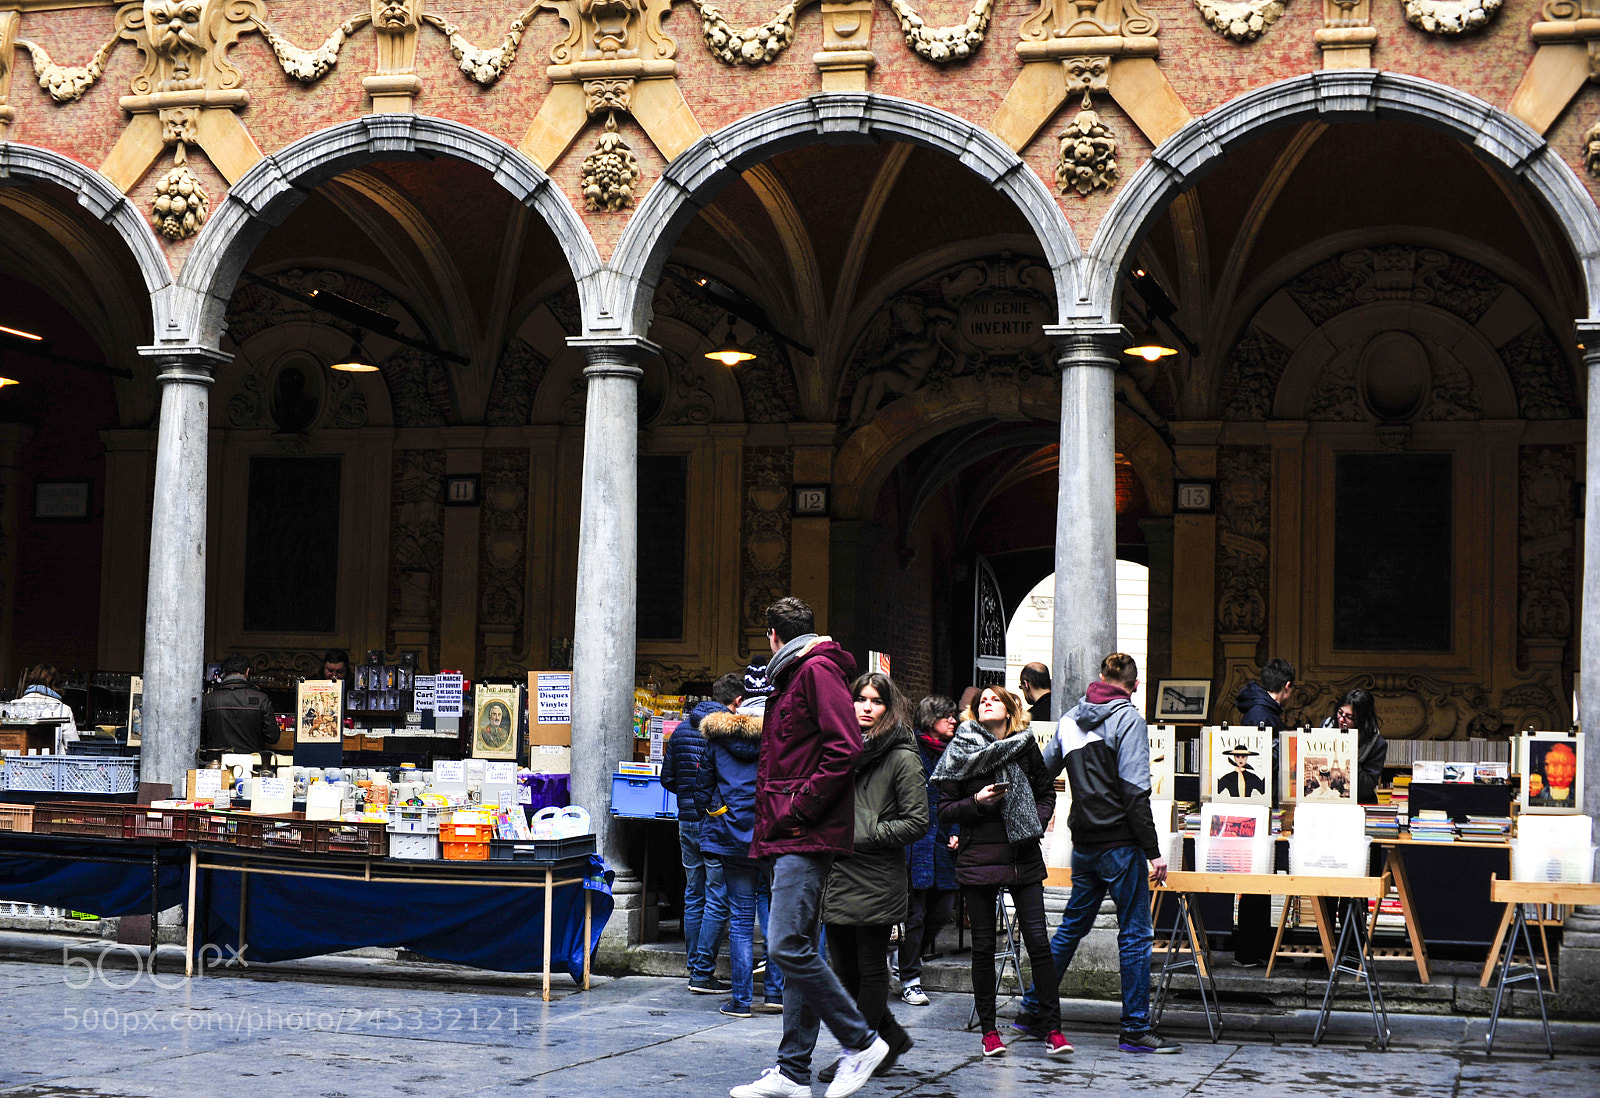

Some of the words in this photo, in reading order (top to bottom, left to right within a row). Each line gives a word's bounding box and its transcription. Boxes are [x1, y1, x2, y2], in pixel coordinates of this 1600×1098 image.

[974, 302, 989, 315] AU
[971, 320, 1034, 335] INVENTIF
[456, 484, 466, 498] 11
[1186, 489, 1206, 506] 13
[803, 493, 821, 510] 12
[1220, 736, 1264, 749] VOGUE
[1306, 740, 1350, 753] VOGUE
